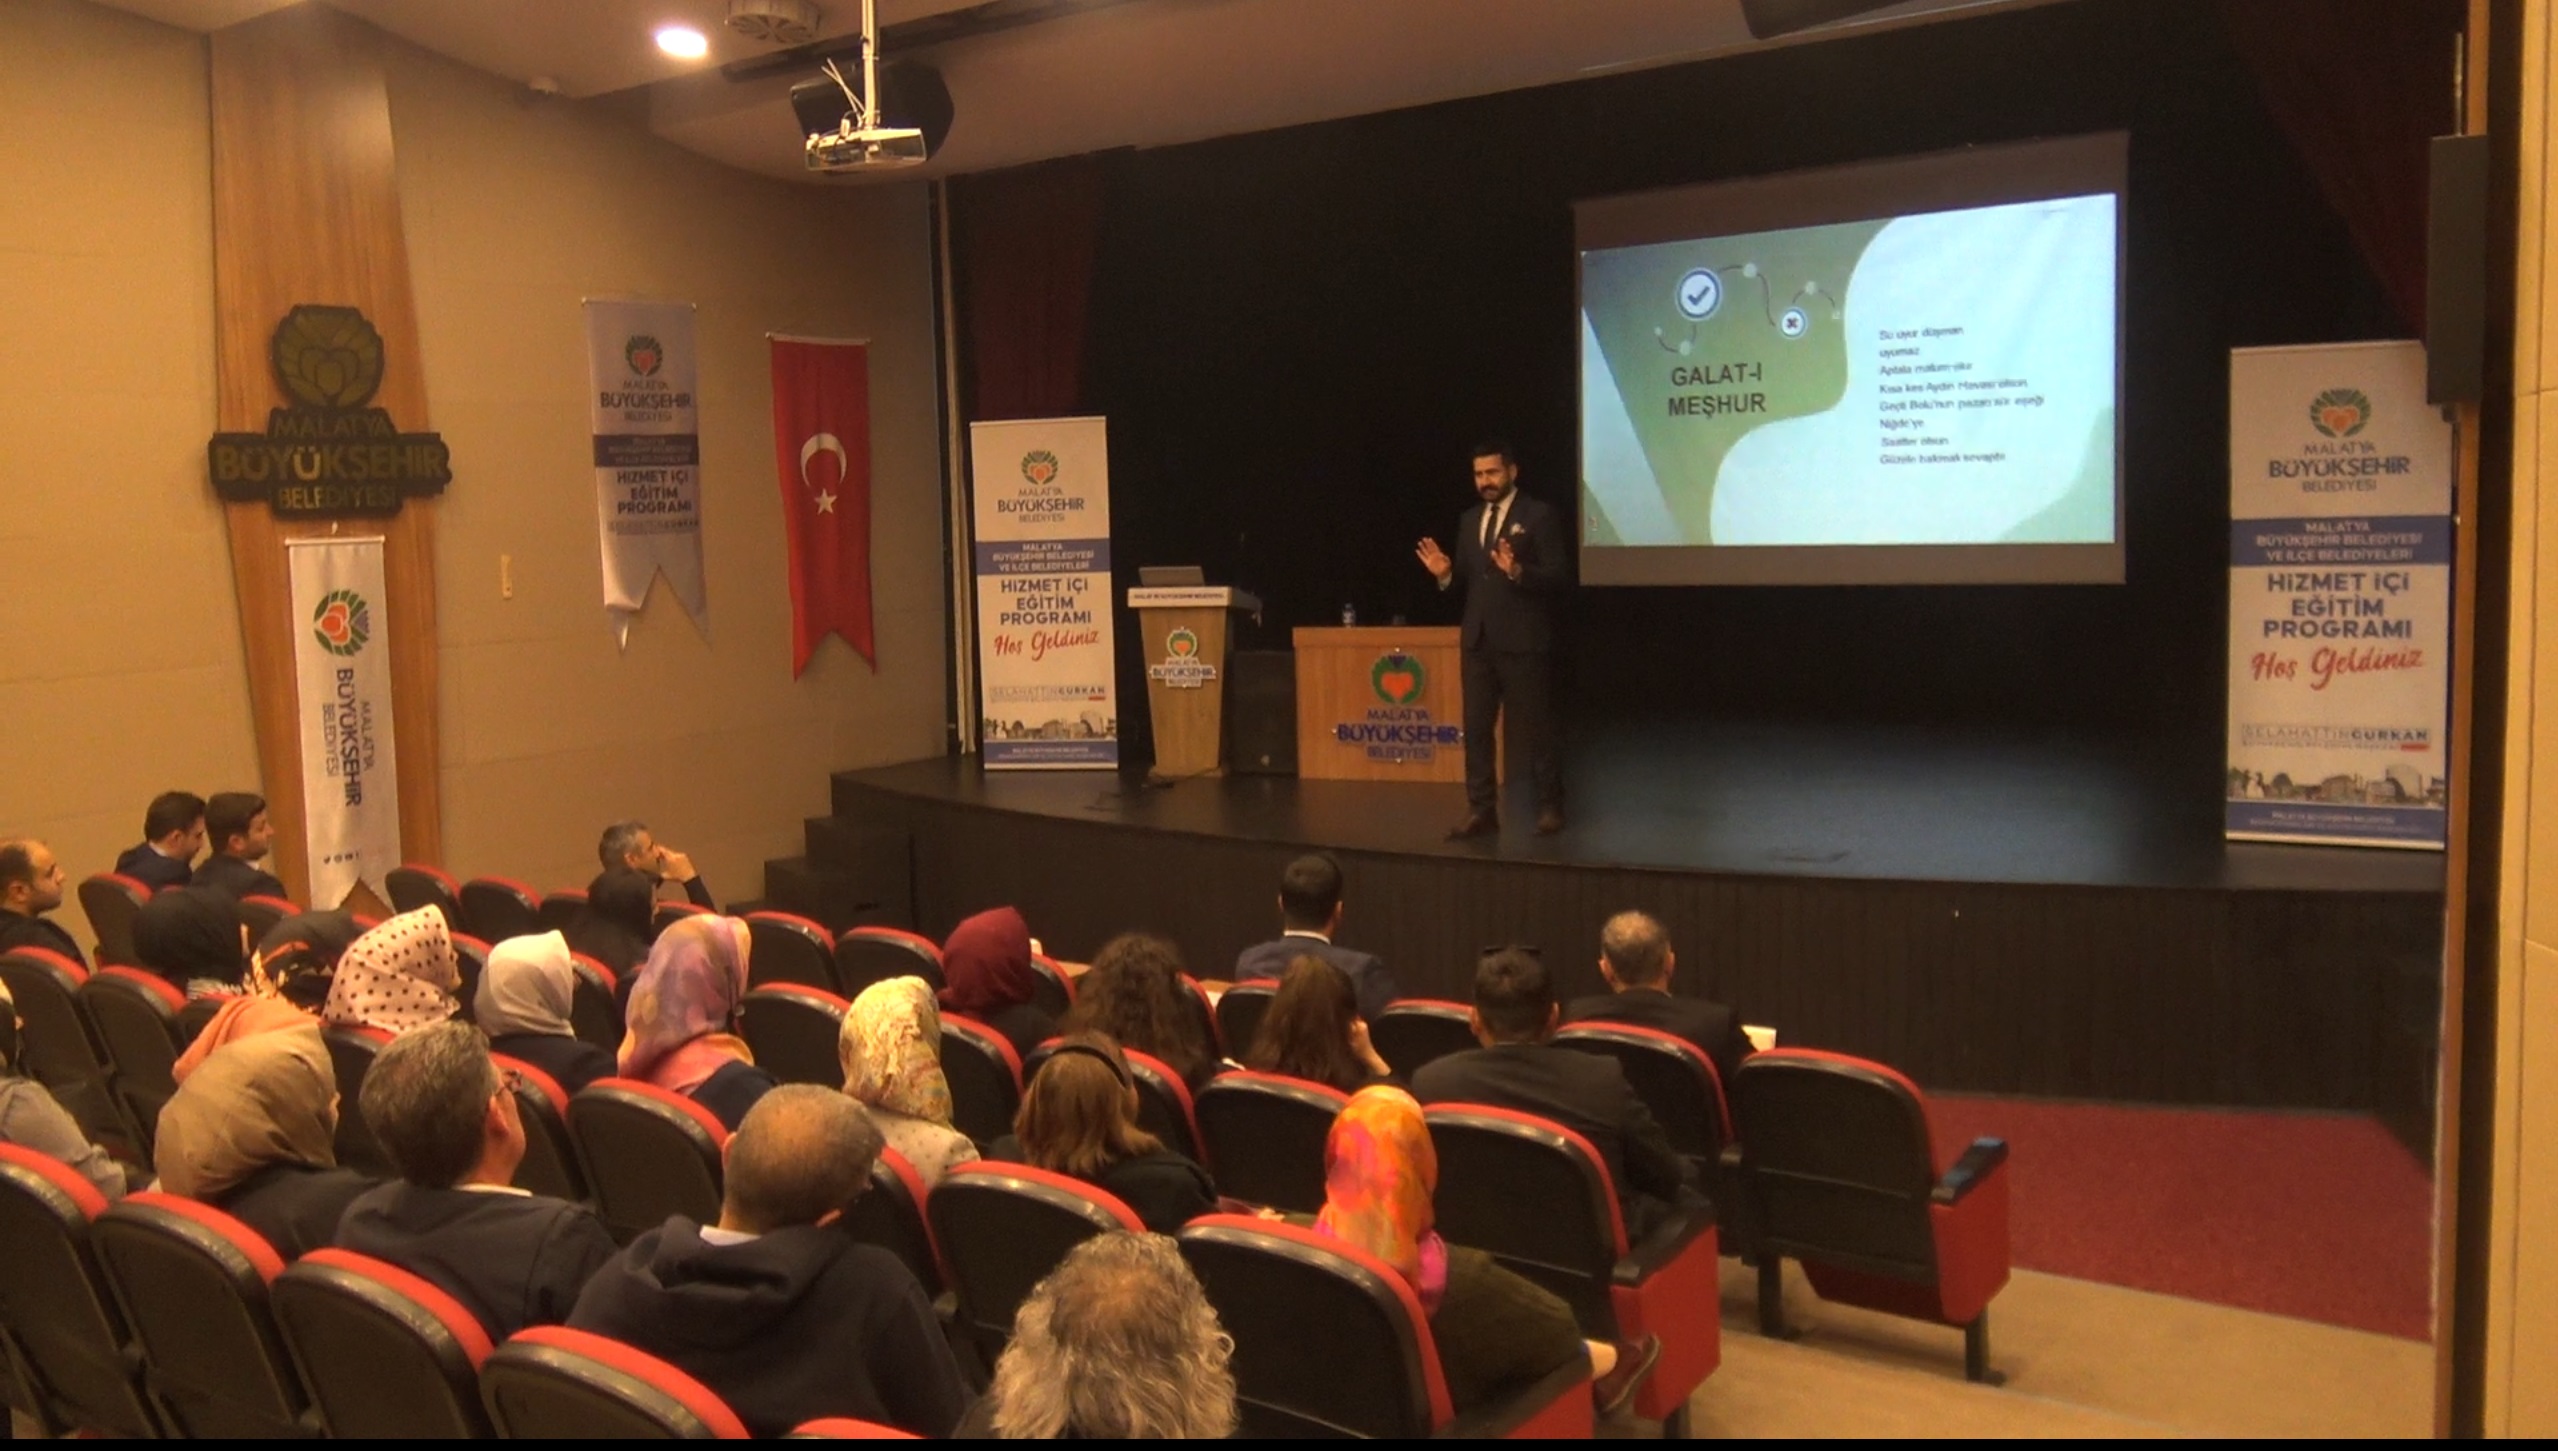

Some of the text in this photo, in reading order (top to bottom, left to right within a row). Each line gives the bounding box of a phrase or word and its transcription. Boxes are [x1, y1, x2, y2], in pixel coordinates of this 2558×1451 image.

[1879, 347, 1919, 358] uyumaz
[1671, 362, 1762, 386] GALAT-I
[1668, 393, 1766, 419] MEŞHUR
[275, 416, 391, 437] MALATYA
[2304, 440, 2376, 456] MALATYA
[630, 485, 679, 500] EĞİTİM
[1018, 487, 1063, 497] MALATYA
[617, 501, 693, 515] PROGRAMI
[2305, 521, 2370, 533] MALATYA
[1022, 543, 1063, 551] MALATYA
[2256, 532, 2423, 548] BÜYÜKŞEHİR BELEDİYESİ
[2267, 548, 2413, 563] VE İLÇE BELEDİYELERİ
[999, 563, 1010, 572] VE
[2267, 571, 2410, 596] HİZMET İÇİ
[1016, 593, 1074, 611] EĞİTİM
[2292, 594, 2384, 617] EĞİTİM
[1000, 611, 1091, 625] PROGRAMI
[2263, 619, 2413, 639] PROGRAMI
[994, 628, 1099, 662] Hoş Geldiniz
[2251, 645, 2424, 691] Hoş Geldiniz
[1367, 708, 1429, 721] MALATYA
[361, 700, 374, 772] MALATYA
